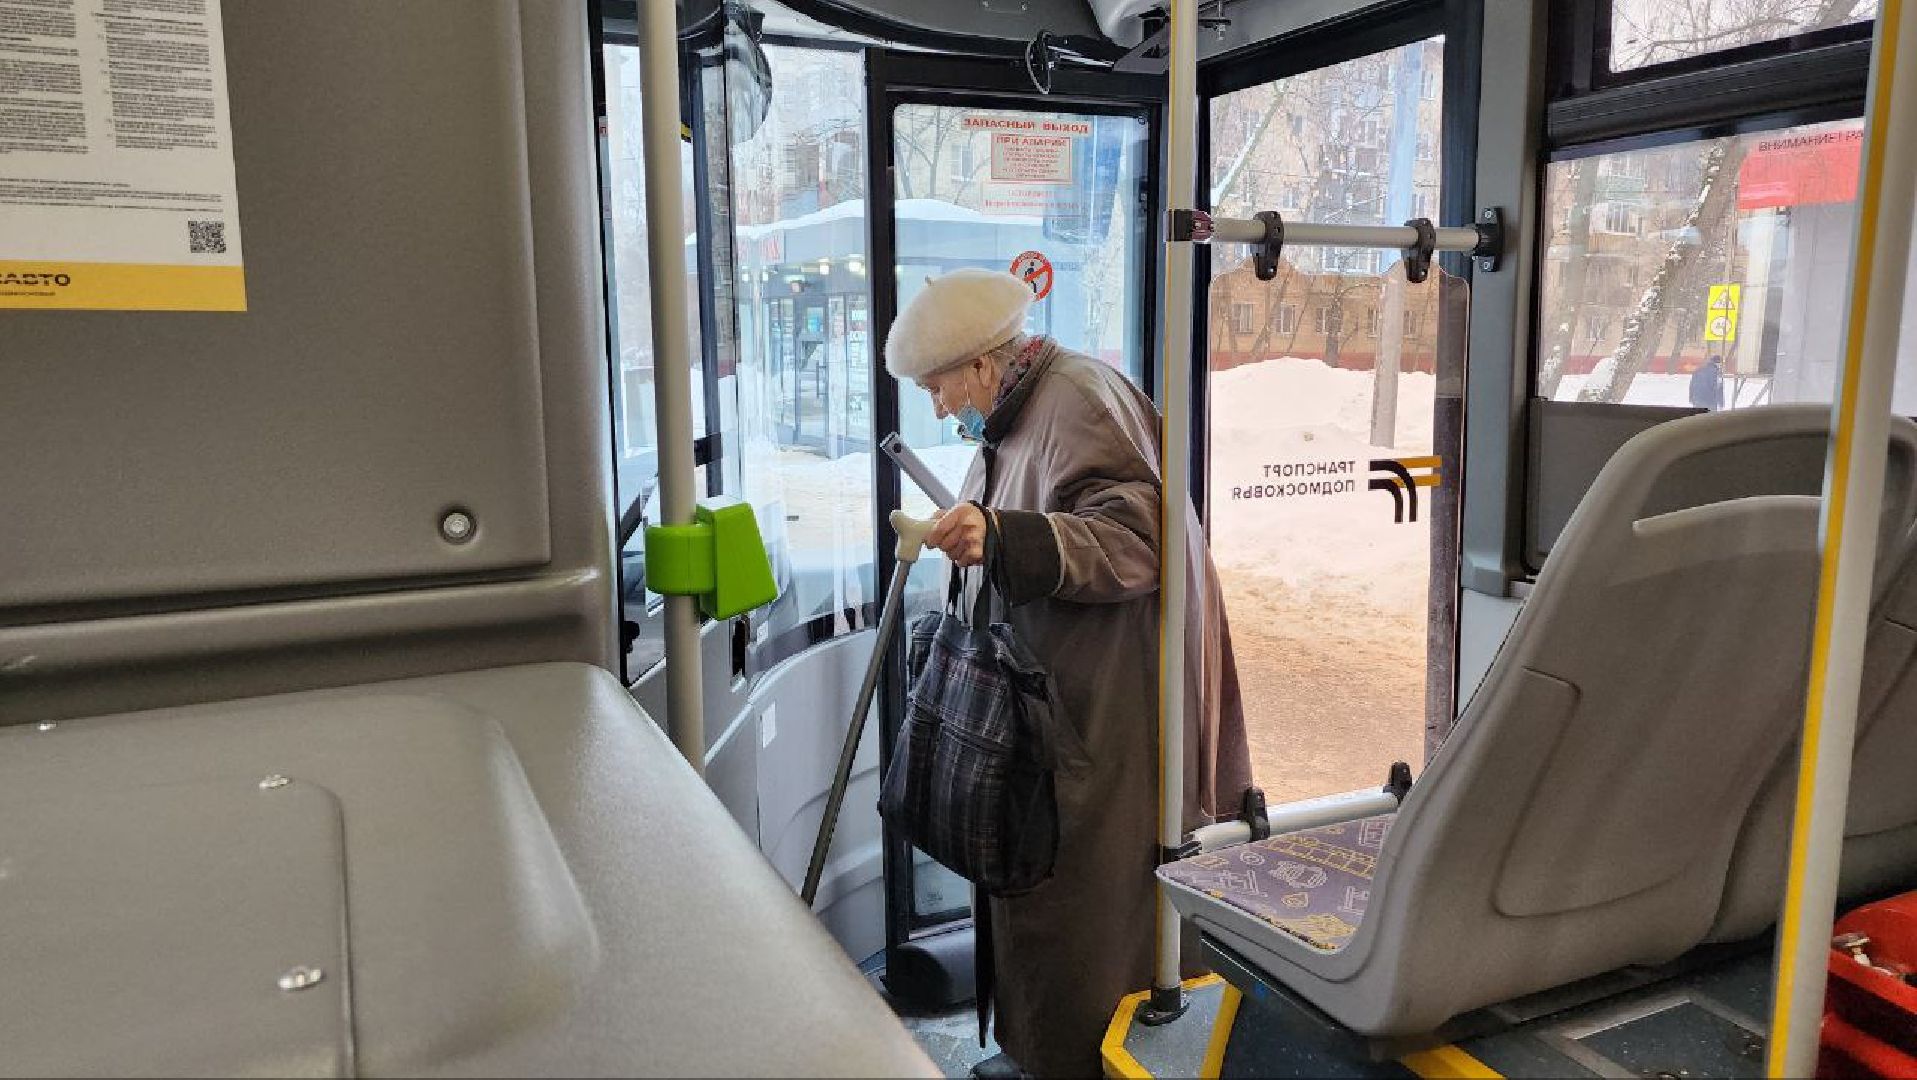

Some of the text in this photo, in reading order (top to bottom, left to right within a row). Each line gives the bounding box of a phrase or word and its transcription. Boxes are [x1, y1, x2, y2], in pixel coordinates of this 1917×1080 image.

[963, 118, 1089, 134] ЗАПАСНЫЙ ВЫХОД
[996, 136, 1019, 145] ПРИ
[0, 273, 71, 287] АВТО
